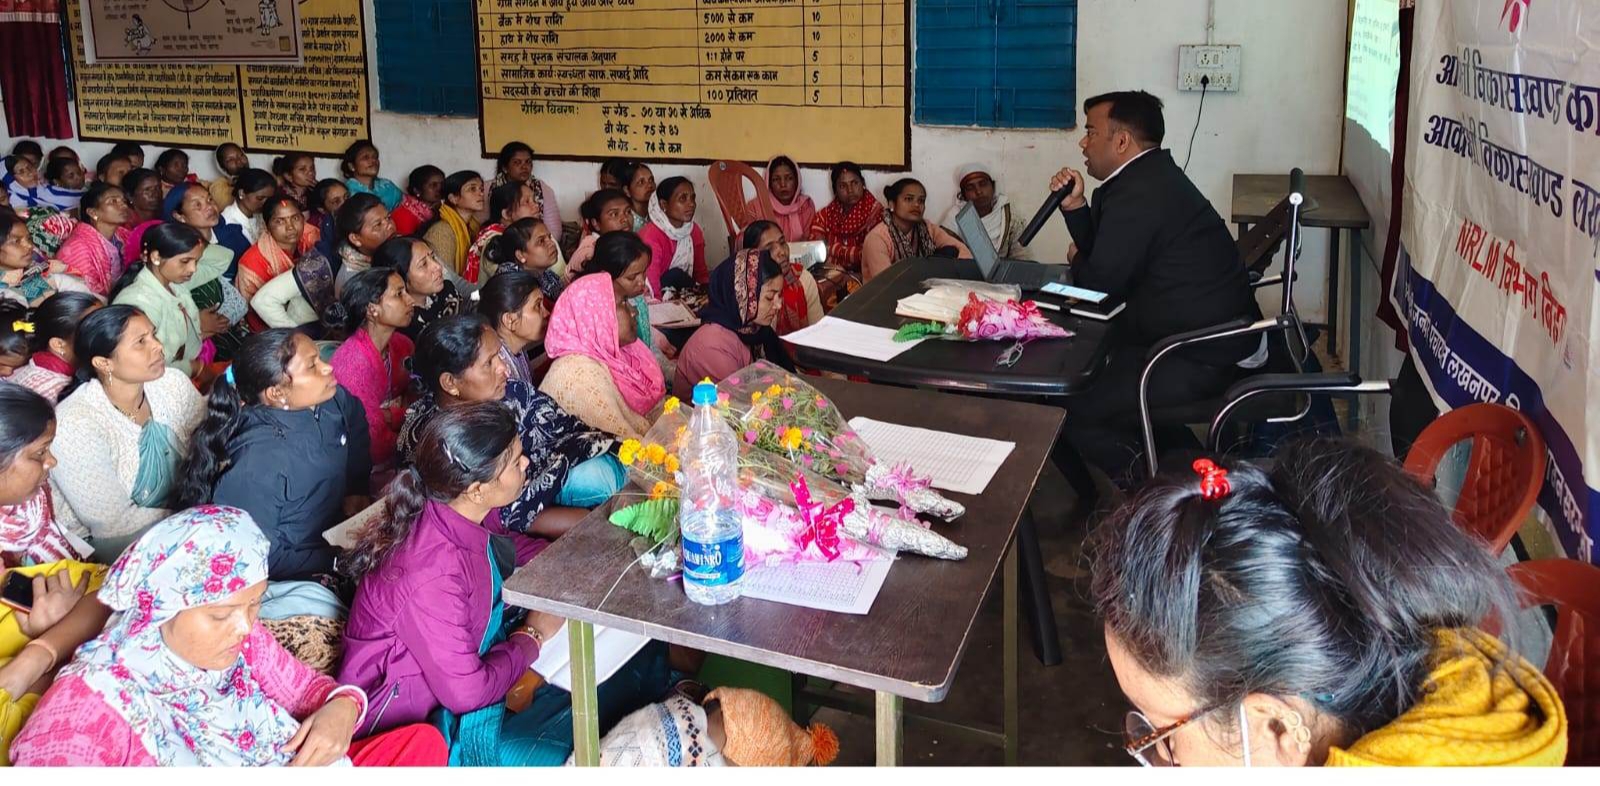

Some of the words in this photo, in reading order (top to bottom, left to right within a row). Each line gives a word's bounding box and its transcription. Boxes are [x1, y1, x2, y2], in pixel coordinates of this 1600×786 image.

[704, 13, 724, 24] 5000
[739, 13, 754, 23] कम
[812, 11, 820, 22] 10
[705, 32, 725, 43] 2000
[739, 32, 756, 41] कम
[812, 31, 820, 41] 10
[591, 50, 617, 65] अनुपात
[706, 52, 717, 61] 1:1
[735, 51, 745, 62] पर
[812, 50, 819, 62] 5
[501, 65, 535, 80] सामाजिक
[610, 66, 631, 83] सफाई
[633, 66, 650, 81] आदि
[705, 70, 722, 81] कम
[731, 70, 746, 80] कम
[762, 70, 778, 81] काम
[812, 70, 819, 83] 5
[582, 83, 601, 100] शिक्षा
[1472, 49, 1567, 124] विकासखण्ड
[707, 90, 723, 101] 100
[726, 87, 758, 104] प्रतिशत
[812, 90, 820, 103] 5
[655, 107, 666, 118] या
[690, 103, 712, 119] अधिक
[643, 125, 655, 136] 75
[645, 141, 656, 153] 74
[668, 142, 682, 154] कम
[1478, 122, 1564, 217] विकासखण्ड
[1456, 217, 1501, 282] NRLM
[1499, 239, 1538, 319] विभाग
[1447, 351, 1501, 404] लखनपर
